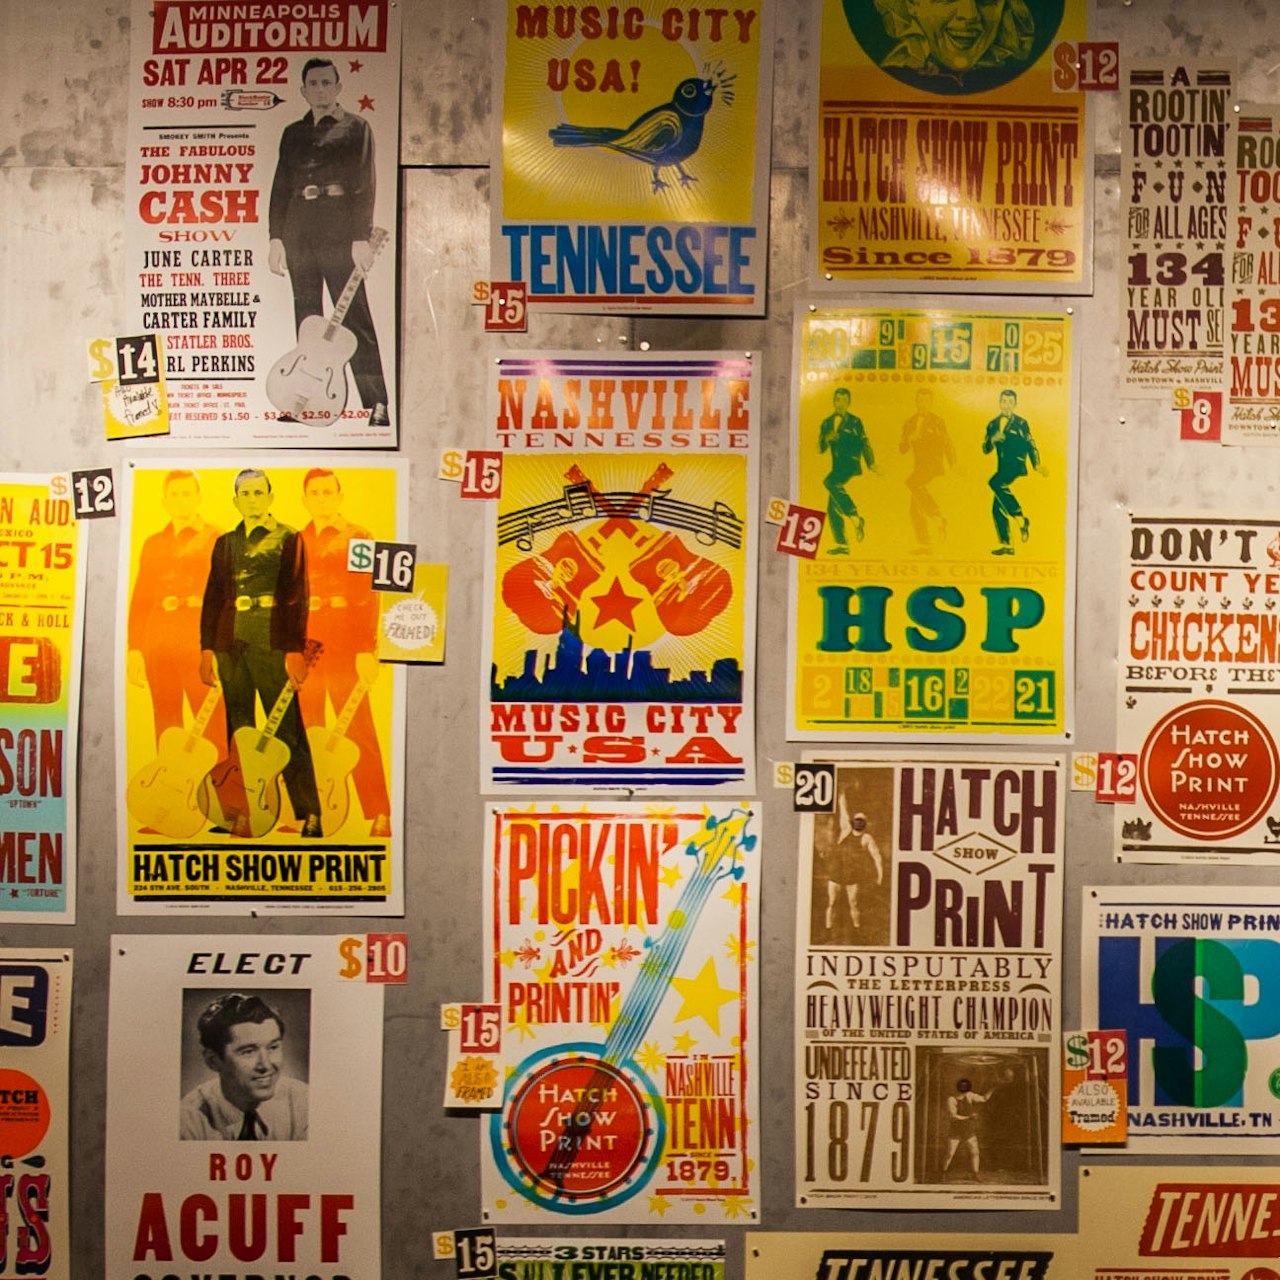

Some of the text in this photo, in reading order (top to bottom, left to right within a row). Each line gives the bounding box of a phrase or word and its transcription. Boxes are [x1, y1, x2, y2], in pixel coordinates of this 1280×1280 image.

[159, 5, 379, 48] AUDITORIUM
[190, 4, 340, 20] MINNEAPOLIS
[516, 5, 758, 44] MUSIC CITY
[143, 57, 288, 86] SAT APR 22
[547, 59, 641, 94] USA!
[142, 97, 217, 110] SHOW 8:30 pm
[140, 164, 254, 184] JOHNNY
[139, 190, 259, 224] CASH
[502, 226, 756, 298] TENNESSEE
[822, 248, 1075, 269] Since 1879
[498, 380, 749, 431] NASHVILLE
[500, 433, 749, 449] TENNESSEE
[38, 614, 70, 629] ROLL
[134, 854, 386, 882] HATCH SHOW PRINT
[508, 823, 678, 927] PICKIN'
[187, 953, 311, 975] ELECT
[806, 956, 1052, 979] INDISPUTABLY
[847, 979, 1011, 992] THE LETTERPRESS
[509, 982, 620, 1025] PRINTIN'
[806, 995, 1052, 1031] HEAVYWEIGHT CHAMPION
[665, 1060, 736, 1098] NASHVILLE
[665, 1100, 736, 1151] TENN
[210, 1153, 278, 1182] ROY
[133, 1194, 355, 1263] ACUFF
[555, 1246, 645, 1260] 3 STARS
